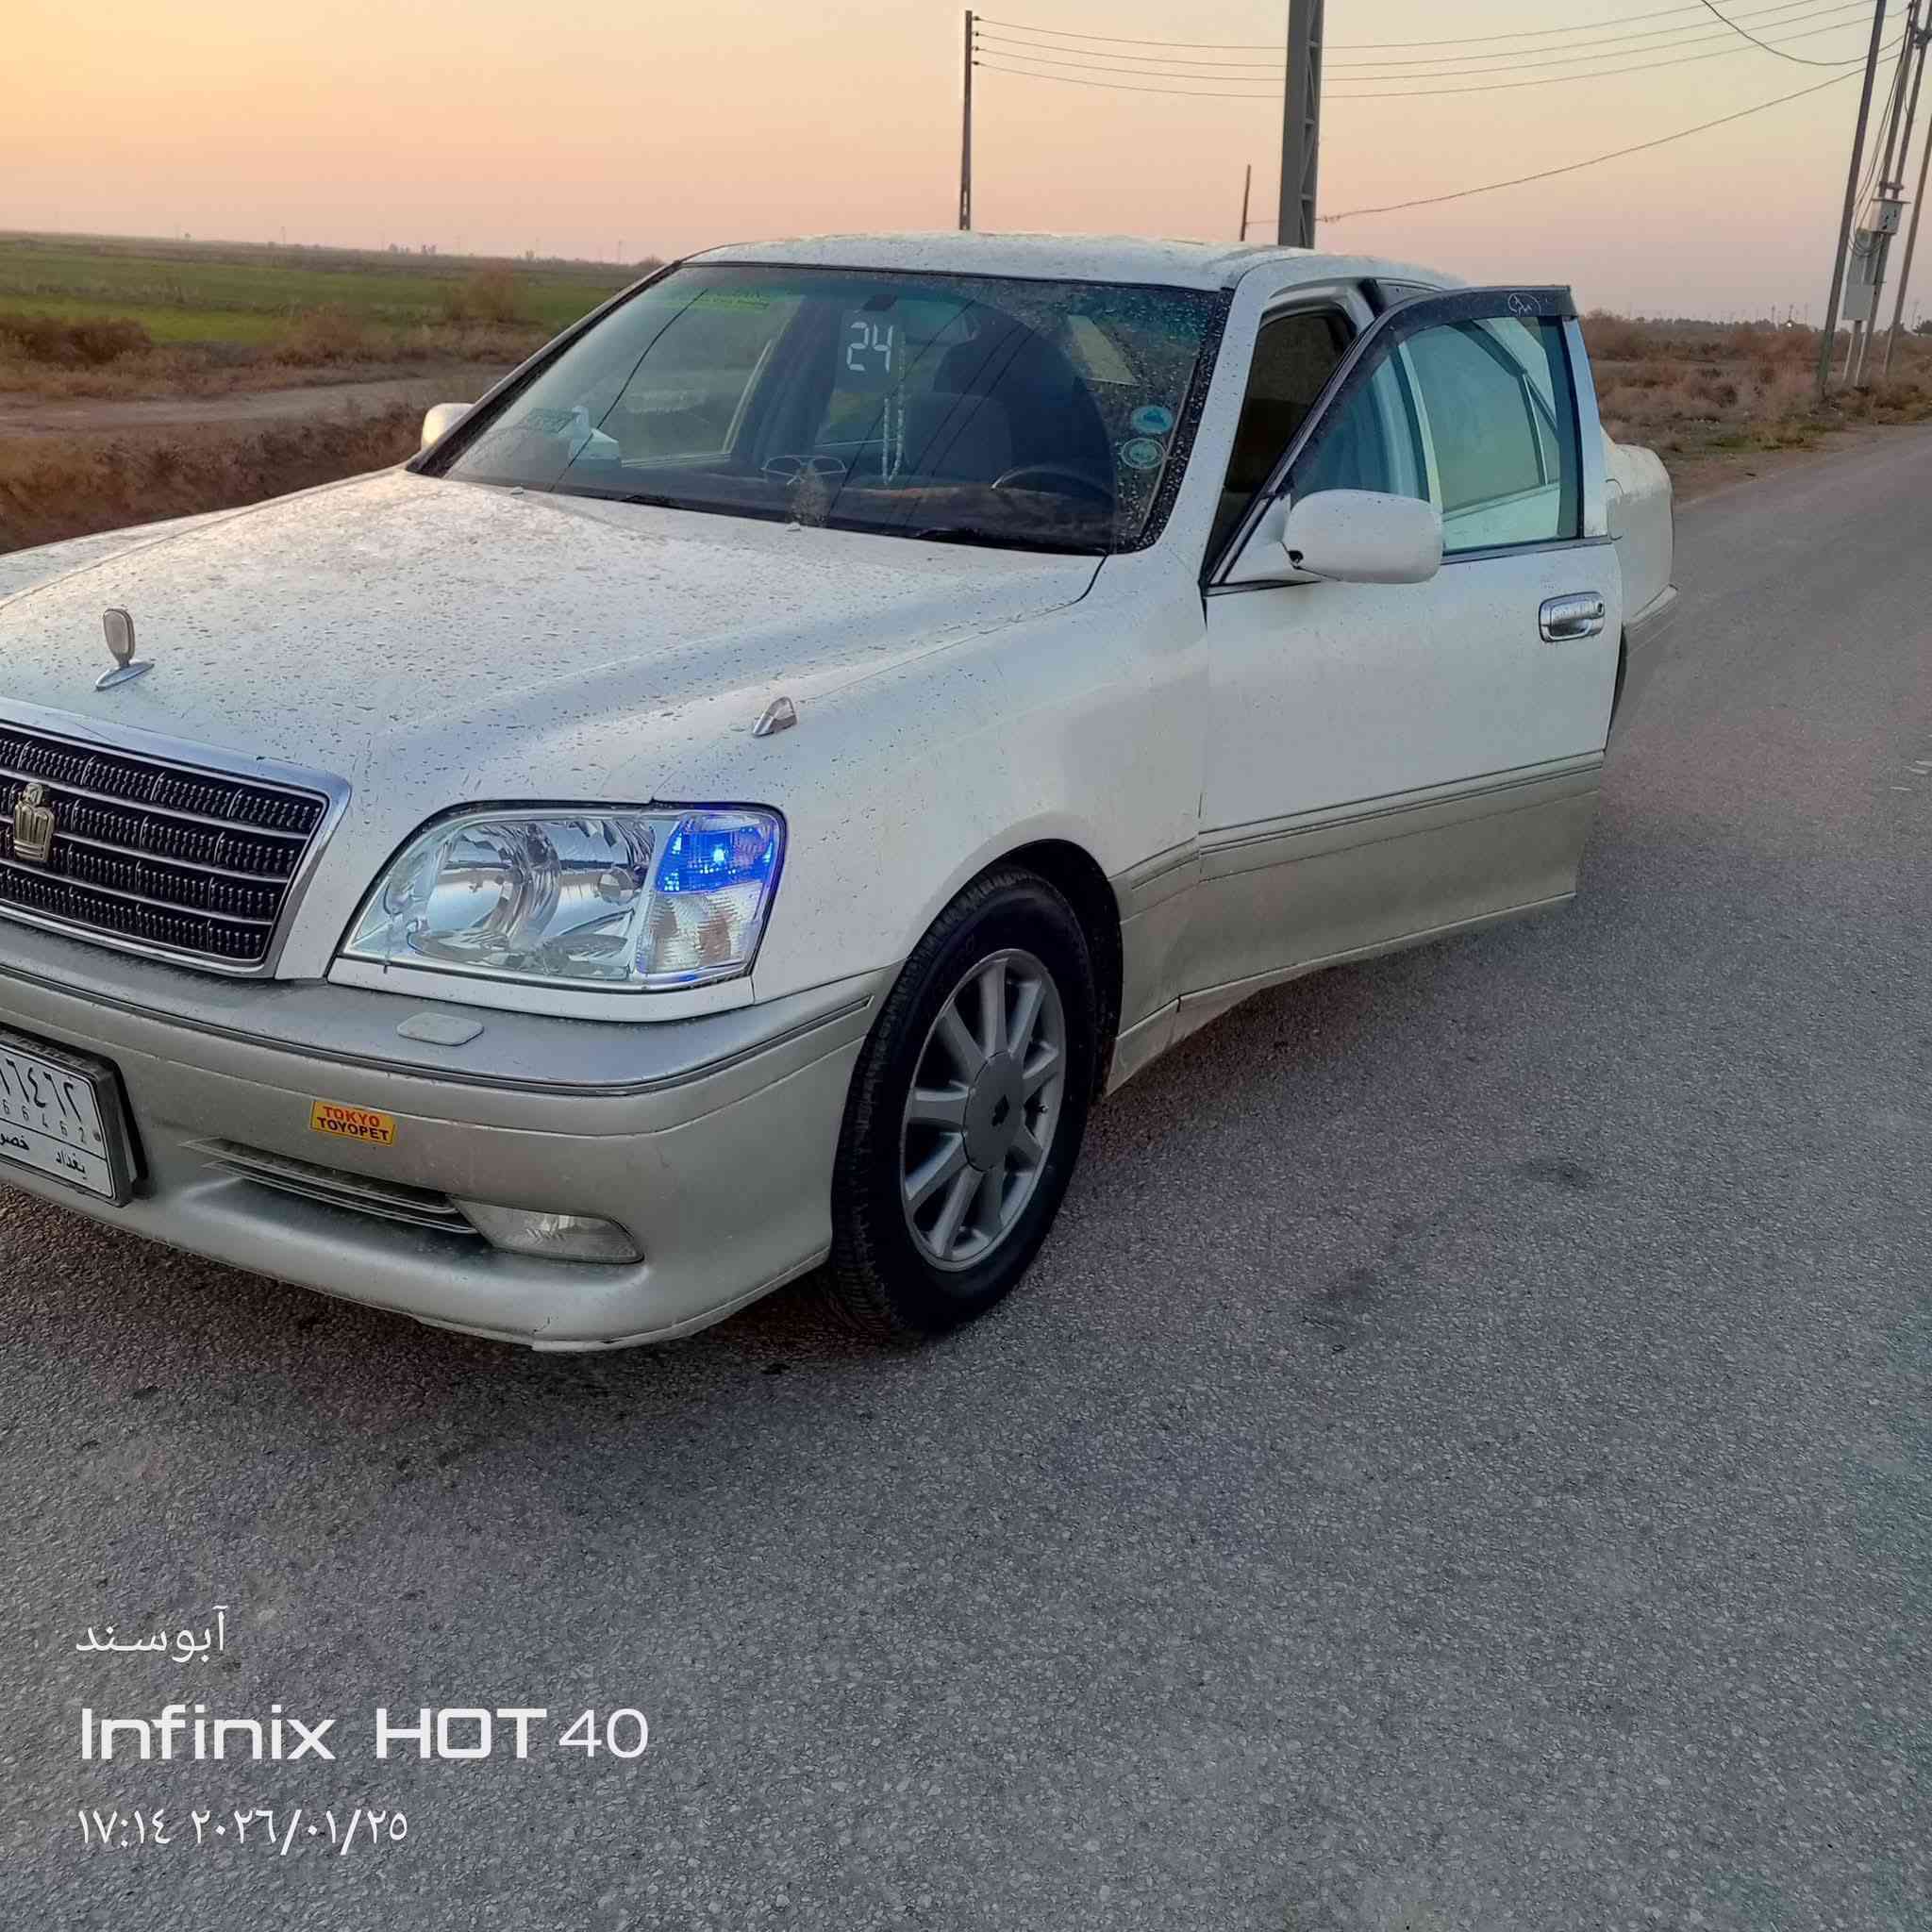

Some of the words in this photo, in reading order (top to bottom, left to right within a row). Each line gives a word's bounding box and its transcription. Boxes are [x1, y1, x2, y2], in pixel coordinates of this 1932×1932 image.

[846, 322, 893, 375] 24
[317, 1117, 390, 1141] TOYOPET
[323, 1106, 381, 1127] TOKYO
[56, 1150, 88, 1180] بغداد
